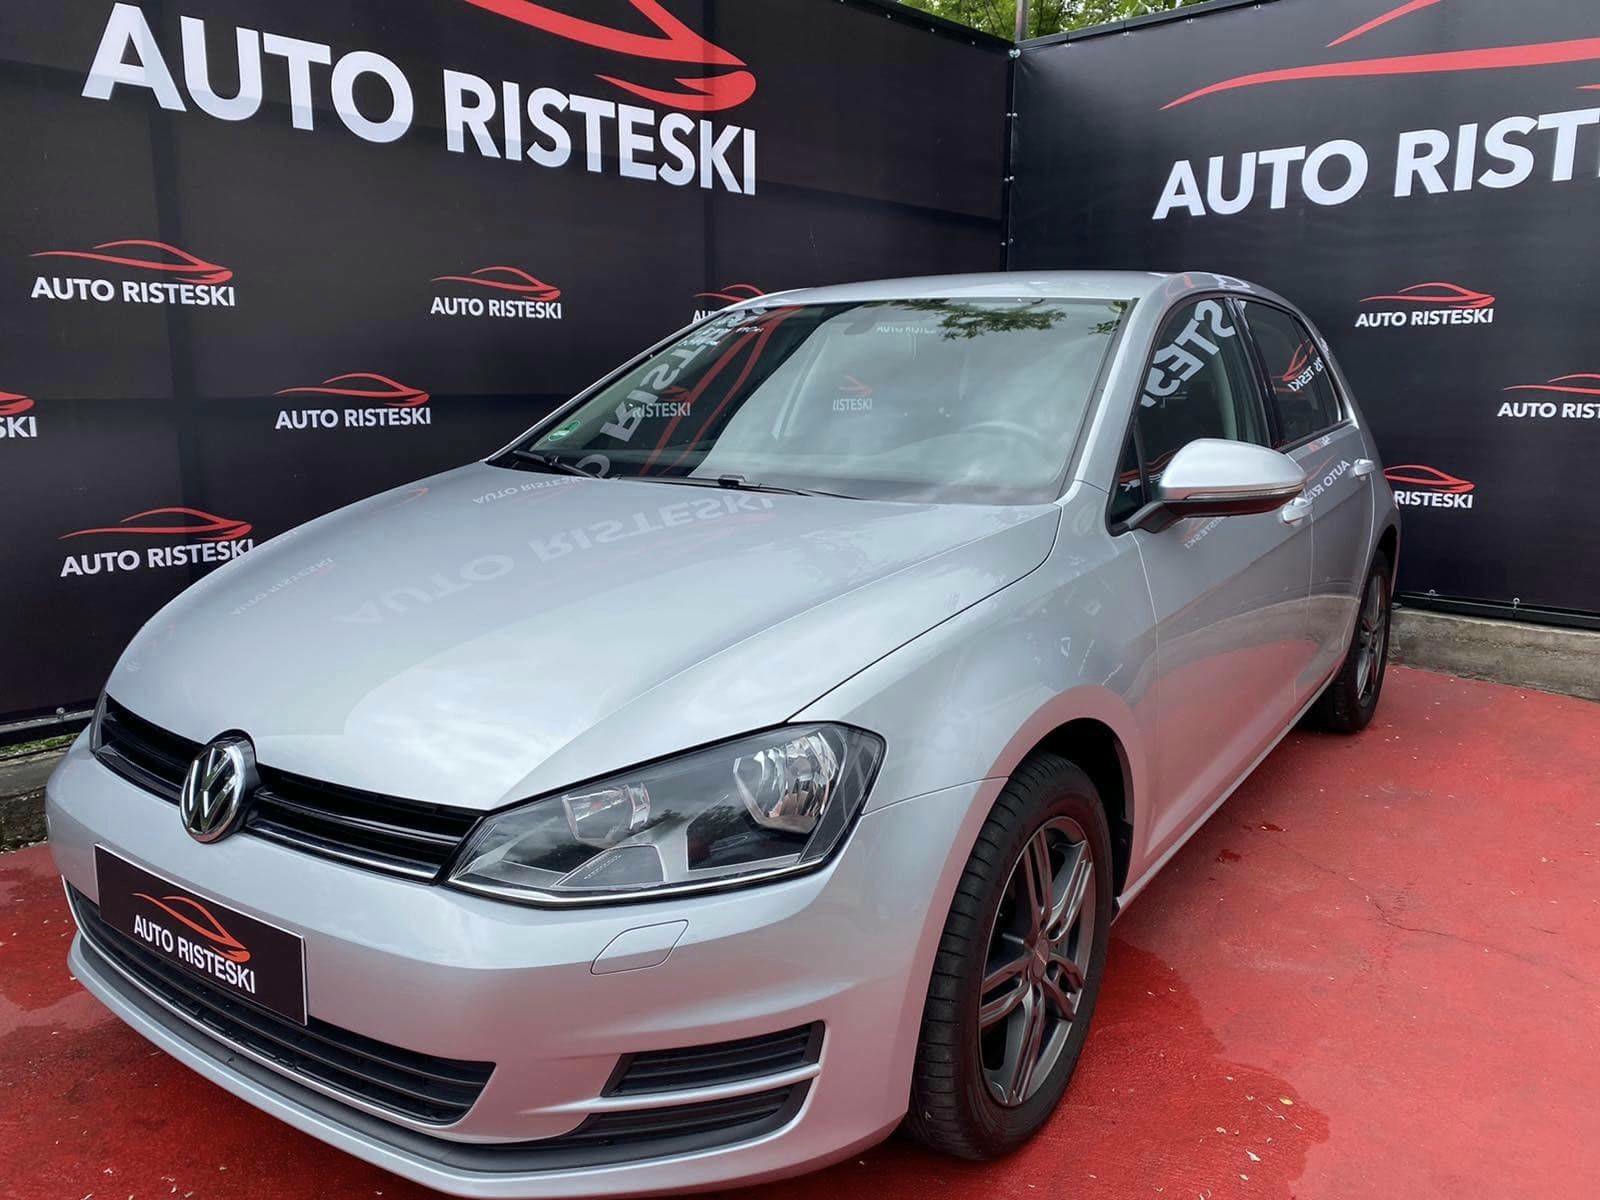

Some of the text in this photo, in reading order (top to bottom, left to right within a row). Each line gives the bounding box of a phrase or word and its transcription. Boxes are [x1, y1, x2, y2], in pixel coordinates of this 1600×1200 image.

[82, 3, 756, 195] AUTO RISTESKI
[1152, 107, 1600, 220] AUTO RIST
[31, 276, 236, 306] AUTO RISTESKI
[430, 296, 561, 319] AUTO RISTESKI
[1355, 308, 1494, 327] AUTO RISTESKI
[275, 408, 432, 429] AUTO RISTESKI
[1497, 402, 1557, 418] AUTO
[1394, 490, 1474, 509] RISTESKI
[60, 538, 255, 577] AUTO RISTESKI
[134, 914, 256, 994] AUTO RISTESKI
